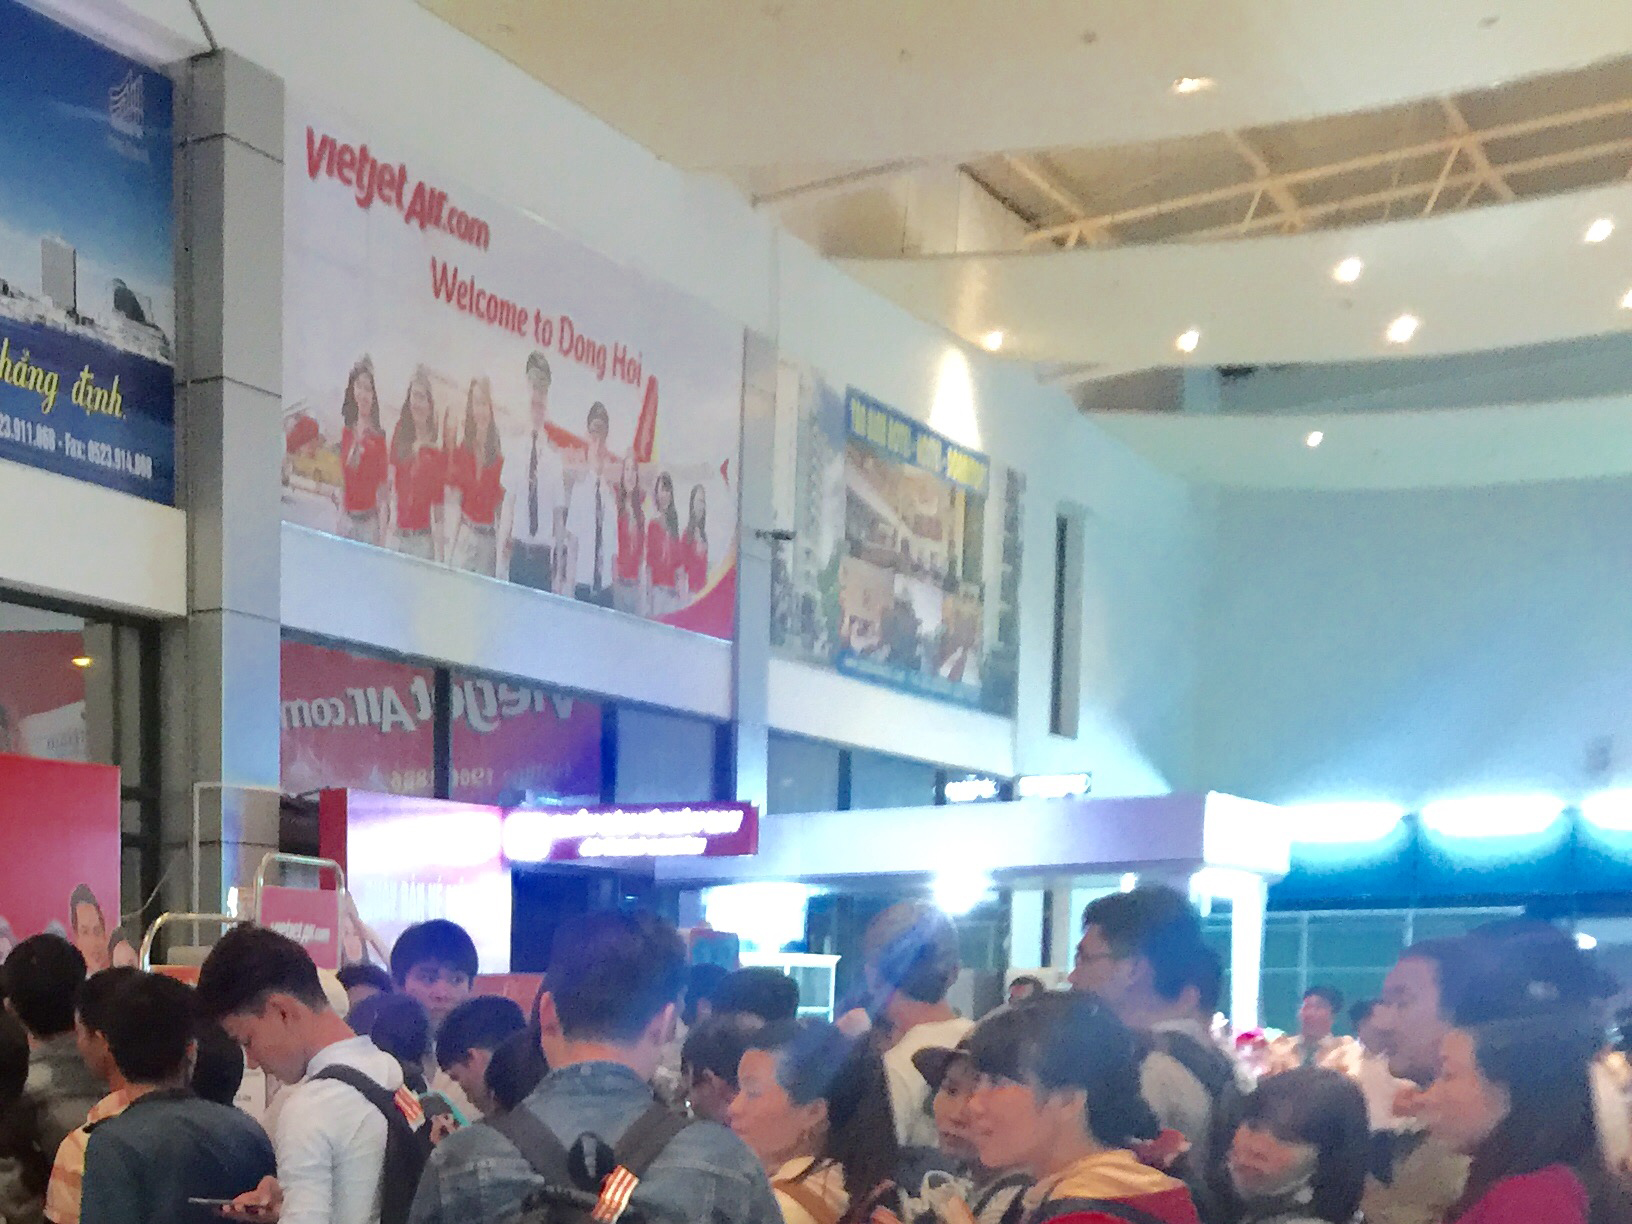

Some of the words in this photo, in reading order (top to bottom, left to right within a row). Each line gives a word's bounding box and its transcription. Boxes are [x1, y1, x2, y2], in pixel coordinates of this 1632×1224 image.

[430, 255, 528, 337] Welcome
[533, 307, 553, 347] to
[558, 314, 607, 381] Dong
[611, 340, 643, 387] Hoi
